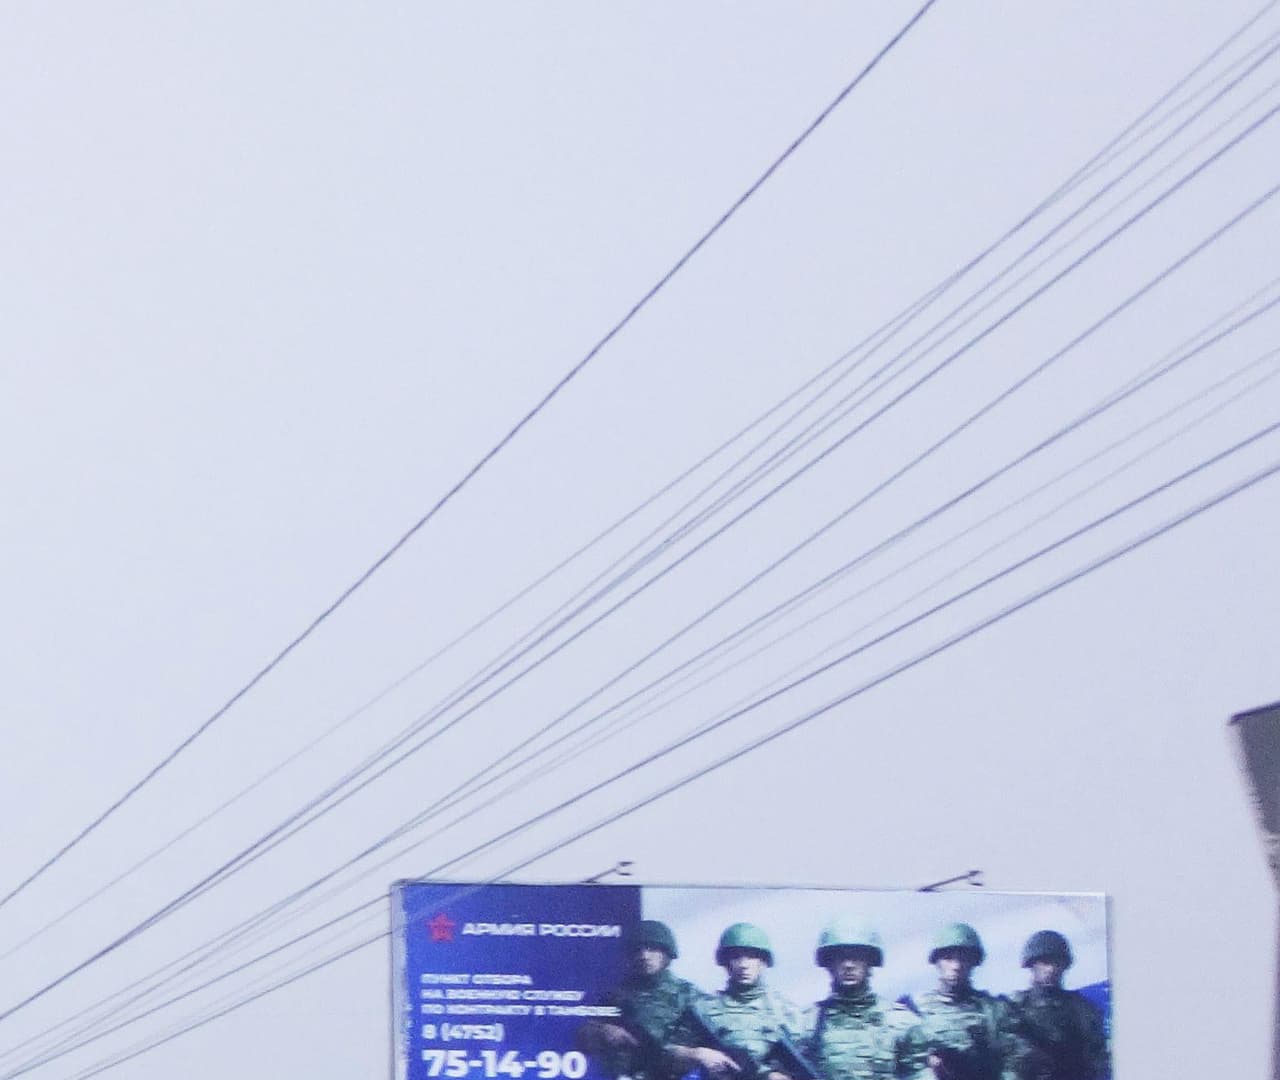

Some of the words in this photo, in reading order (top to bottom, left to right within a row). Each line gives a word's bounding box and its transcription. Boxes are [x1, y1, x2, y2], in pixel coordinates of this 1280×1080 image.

[462, 922, 536, 936] АРМИЯ
[539, 923, 621, 938] РОССИИ
[422, 1049, 587, 1079] 75-14-90
